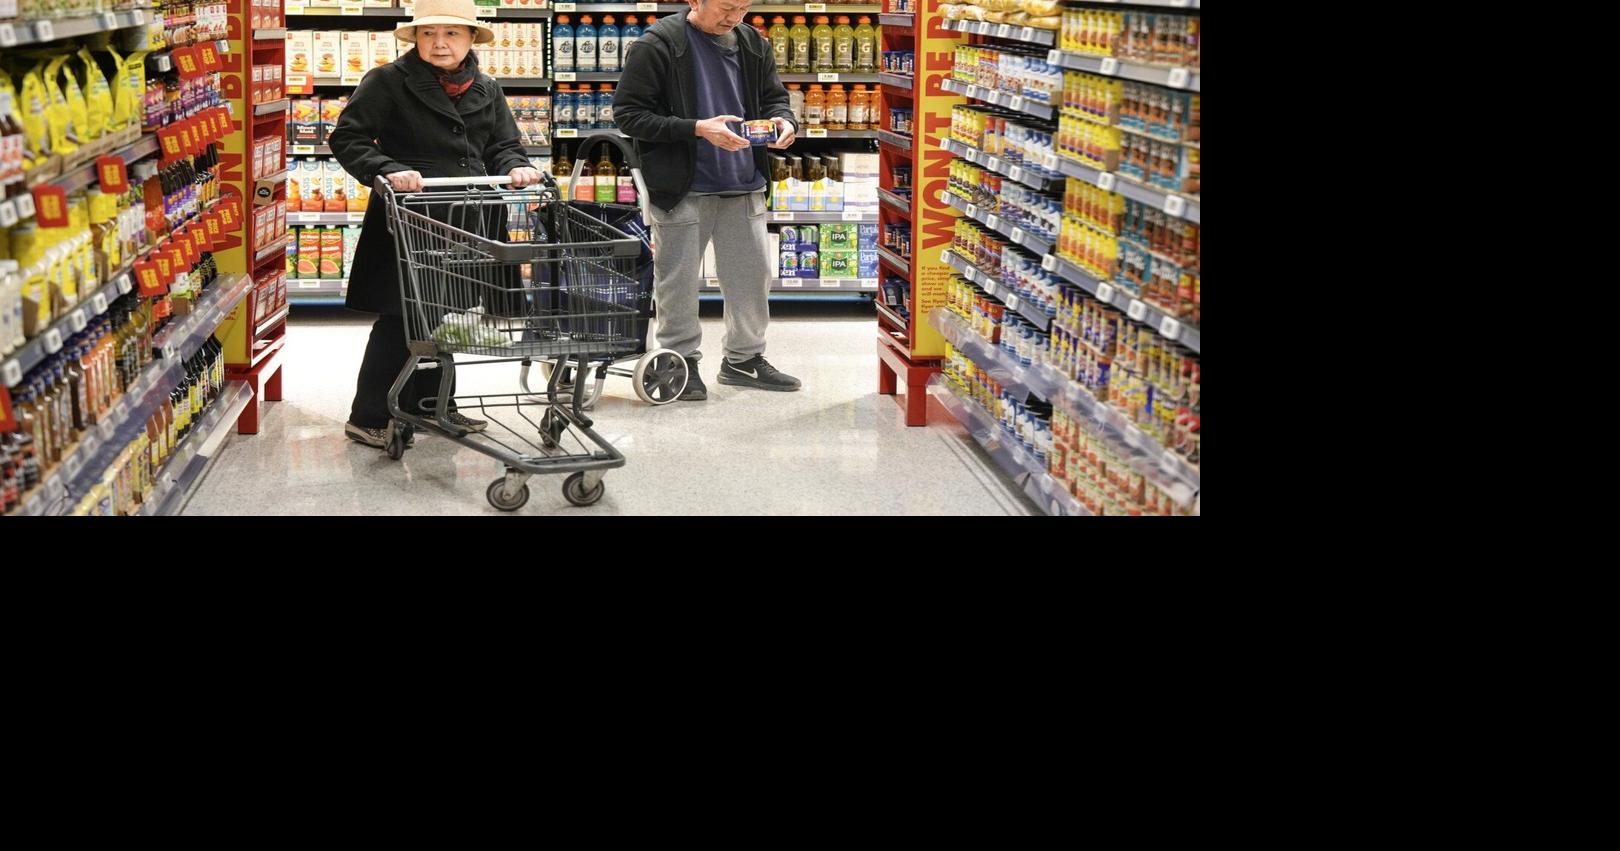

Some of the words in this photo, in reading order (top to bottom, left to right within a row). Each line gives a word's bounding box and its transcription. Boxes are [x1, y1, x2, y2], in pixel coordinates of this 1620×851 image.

[776, 43, 785, 52] G
[798, 43, 807, 52] G
[822, 43, 830, 52] G
[838, 43, 848, 52] G
[862, 43, 870, 52] G
[925, 52, 959, 97] BE
[562, 108, 570, 116] G
[577, 108, 586, 116] G
[601, 108, 611, 116] G
[922, 112, 958, 250] WON'T
